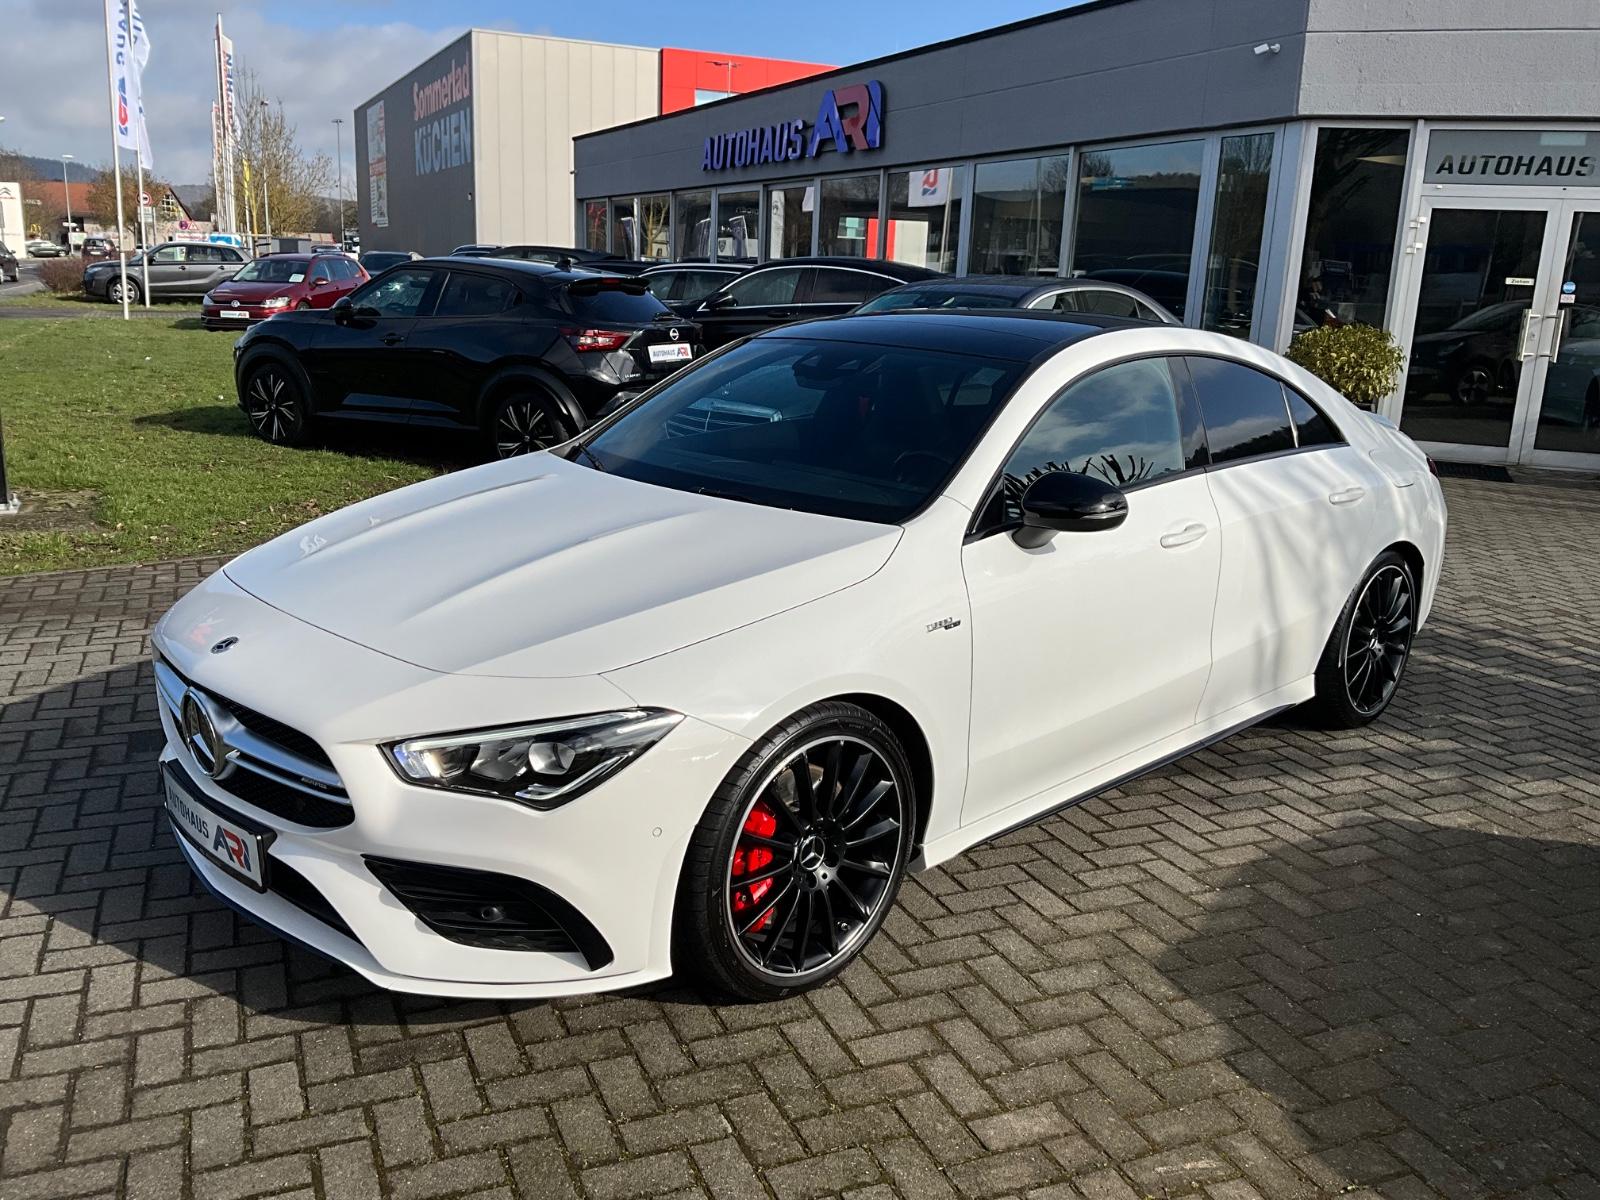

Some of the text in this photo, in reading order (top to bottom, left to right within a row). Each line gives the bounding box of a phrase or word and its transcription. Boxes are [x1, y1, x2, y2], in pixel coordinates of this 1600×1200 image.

[413, 51, 470, 121] Sommerlad
[414, 107, 471, 176] KÜCHEN
[703, 80, 883, 171] AUTOHAUS ARI
[1435, 154, 1596, 177] AUTOHAUS
[168, 785, 251, 873] AUTOHAUS ARI
